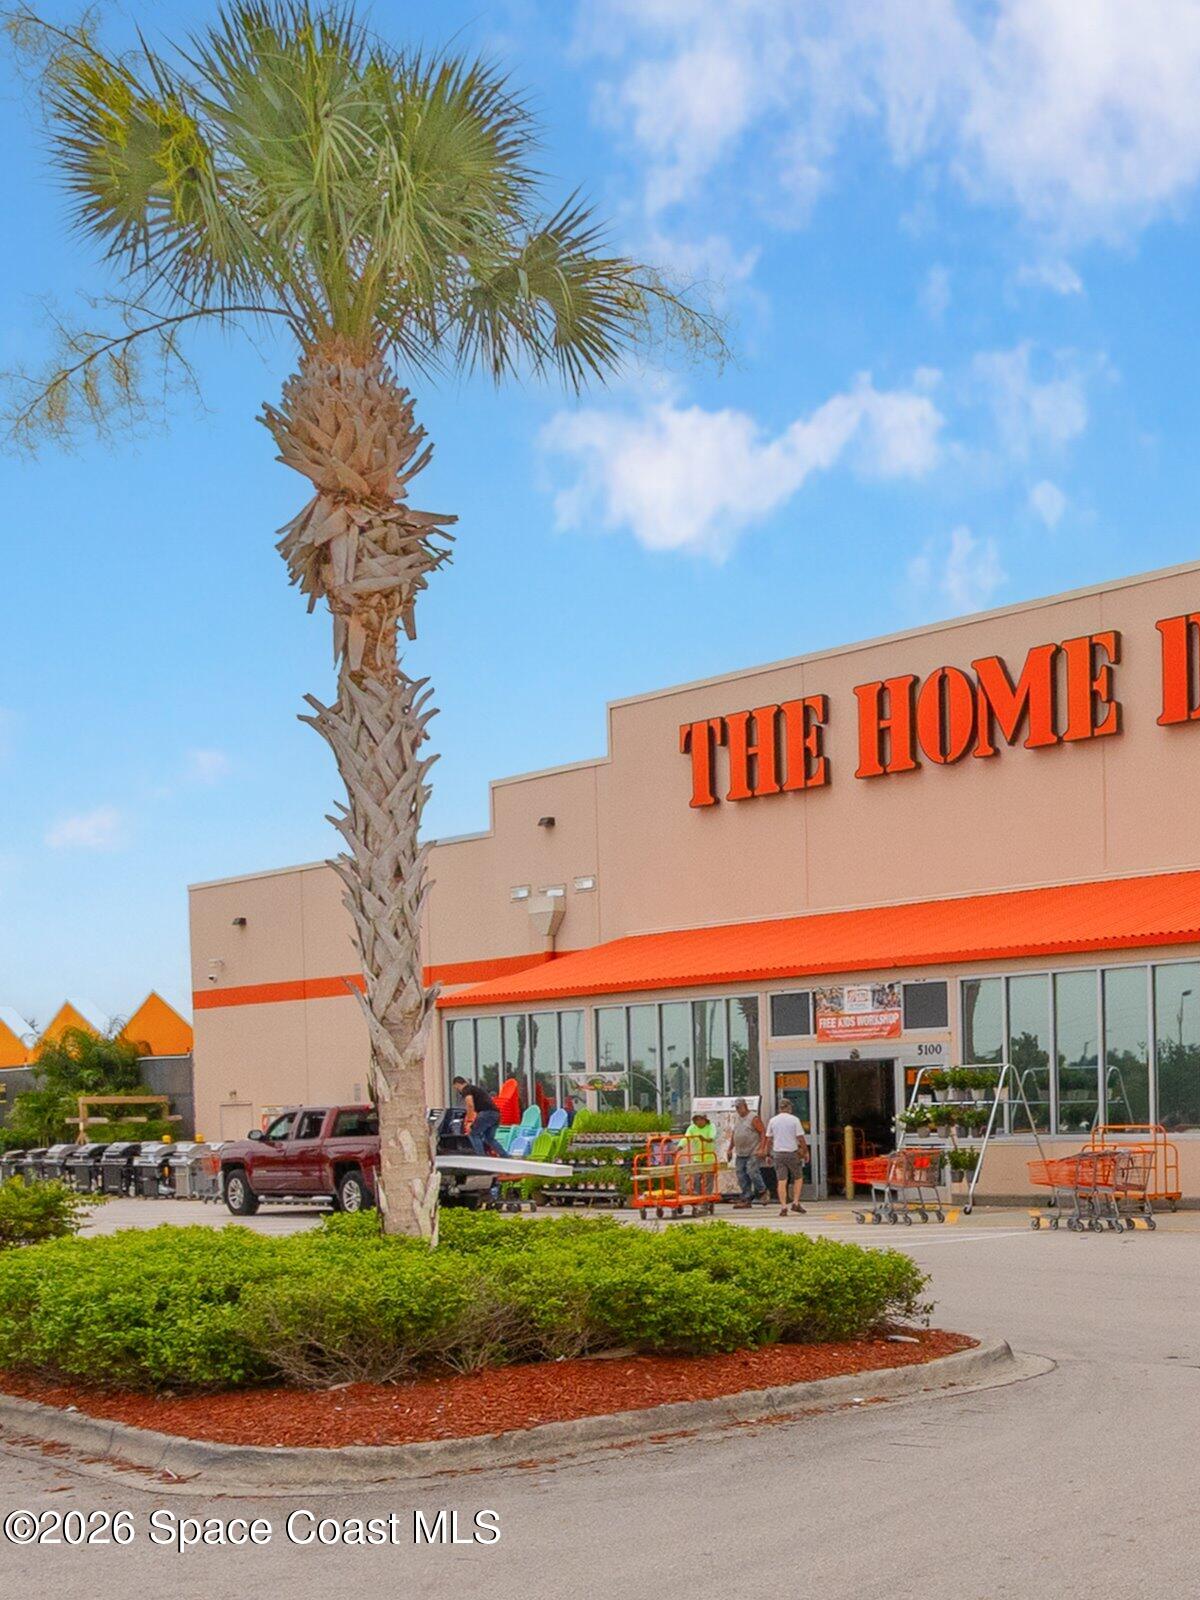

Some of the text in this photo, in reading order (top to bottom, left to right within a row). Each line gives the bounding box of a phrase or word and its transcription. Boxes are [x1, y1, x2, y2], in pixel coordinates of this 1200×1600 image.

[679, 693, 829, 808] THE
[853, 630, 1122, 779] HOME
[819, 1012, 900, 1029] FREE KIDS WORKSHOP
[917, 1044, 943, 1056] 5100
